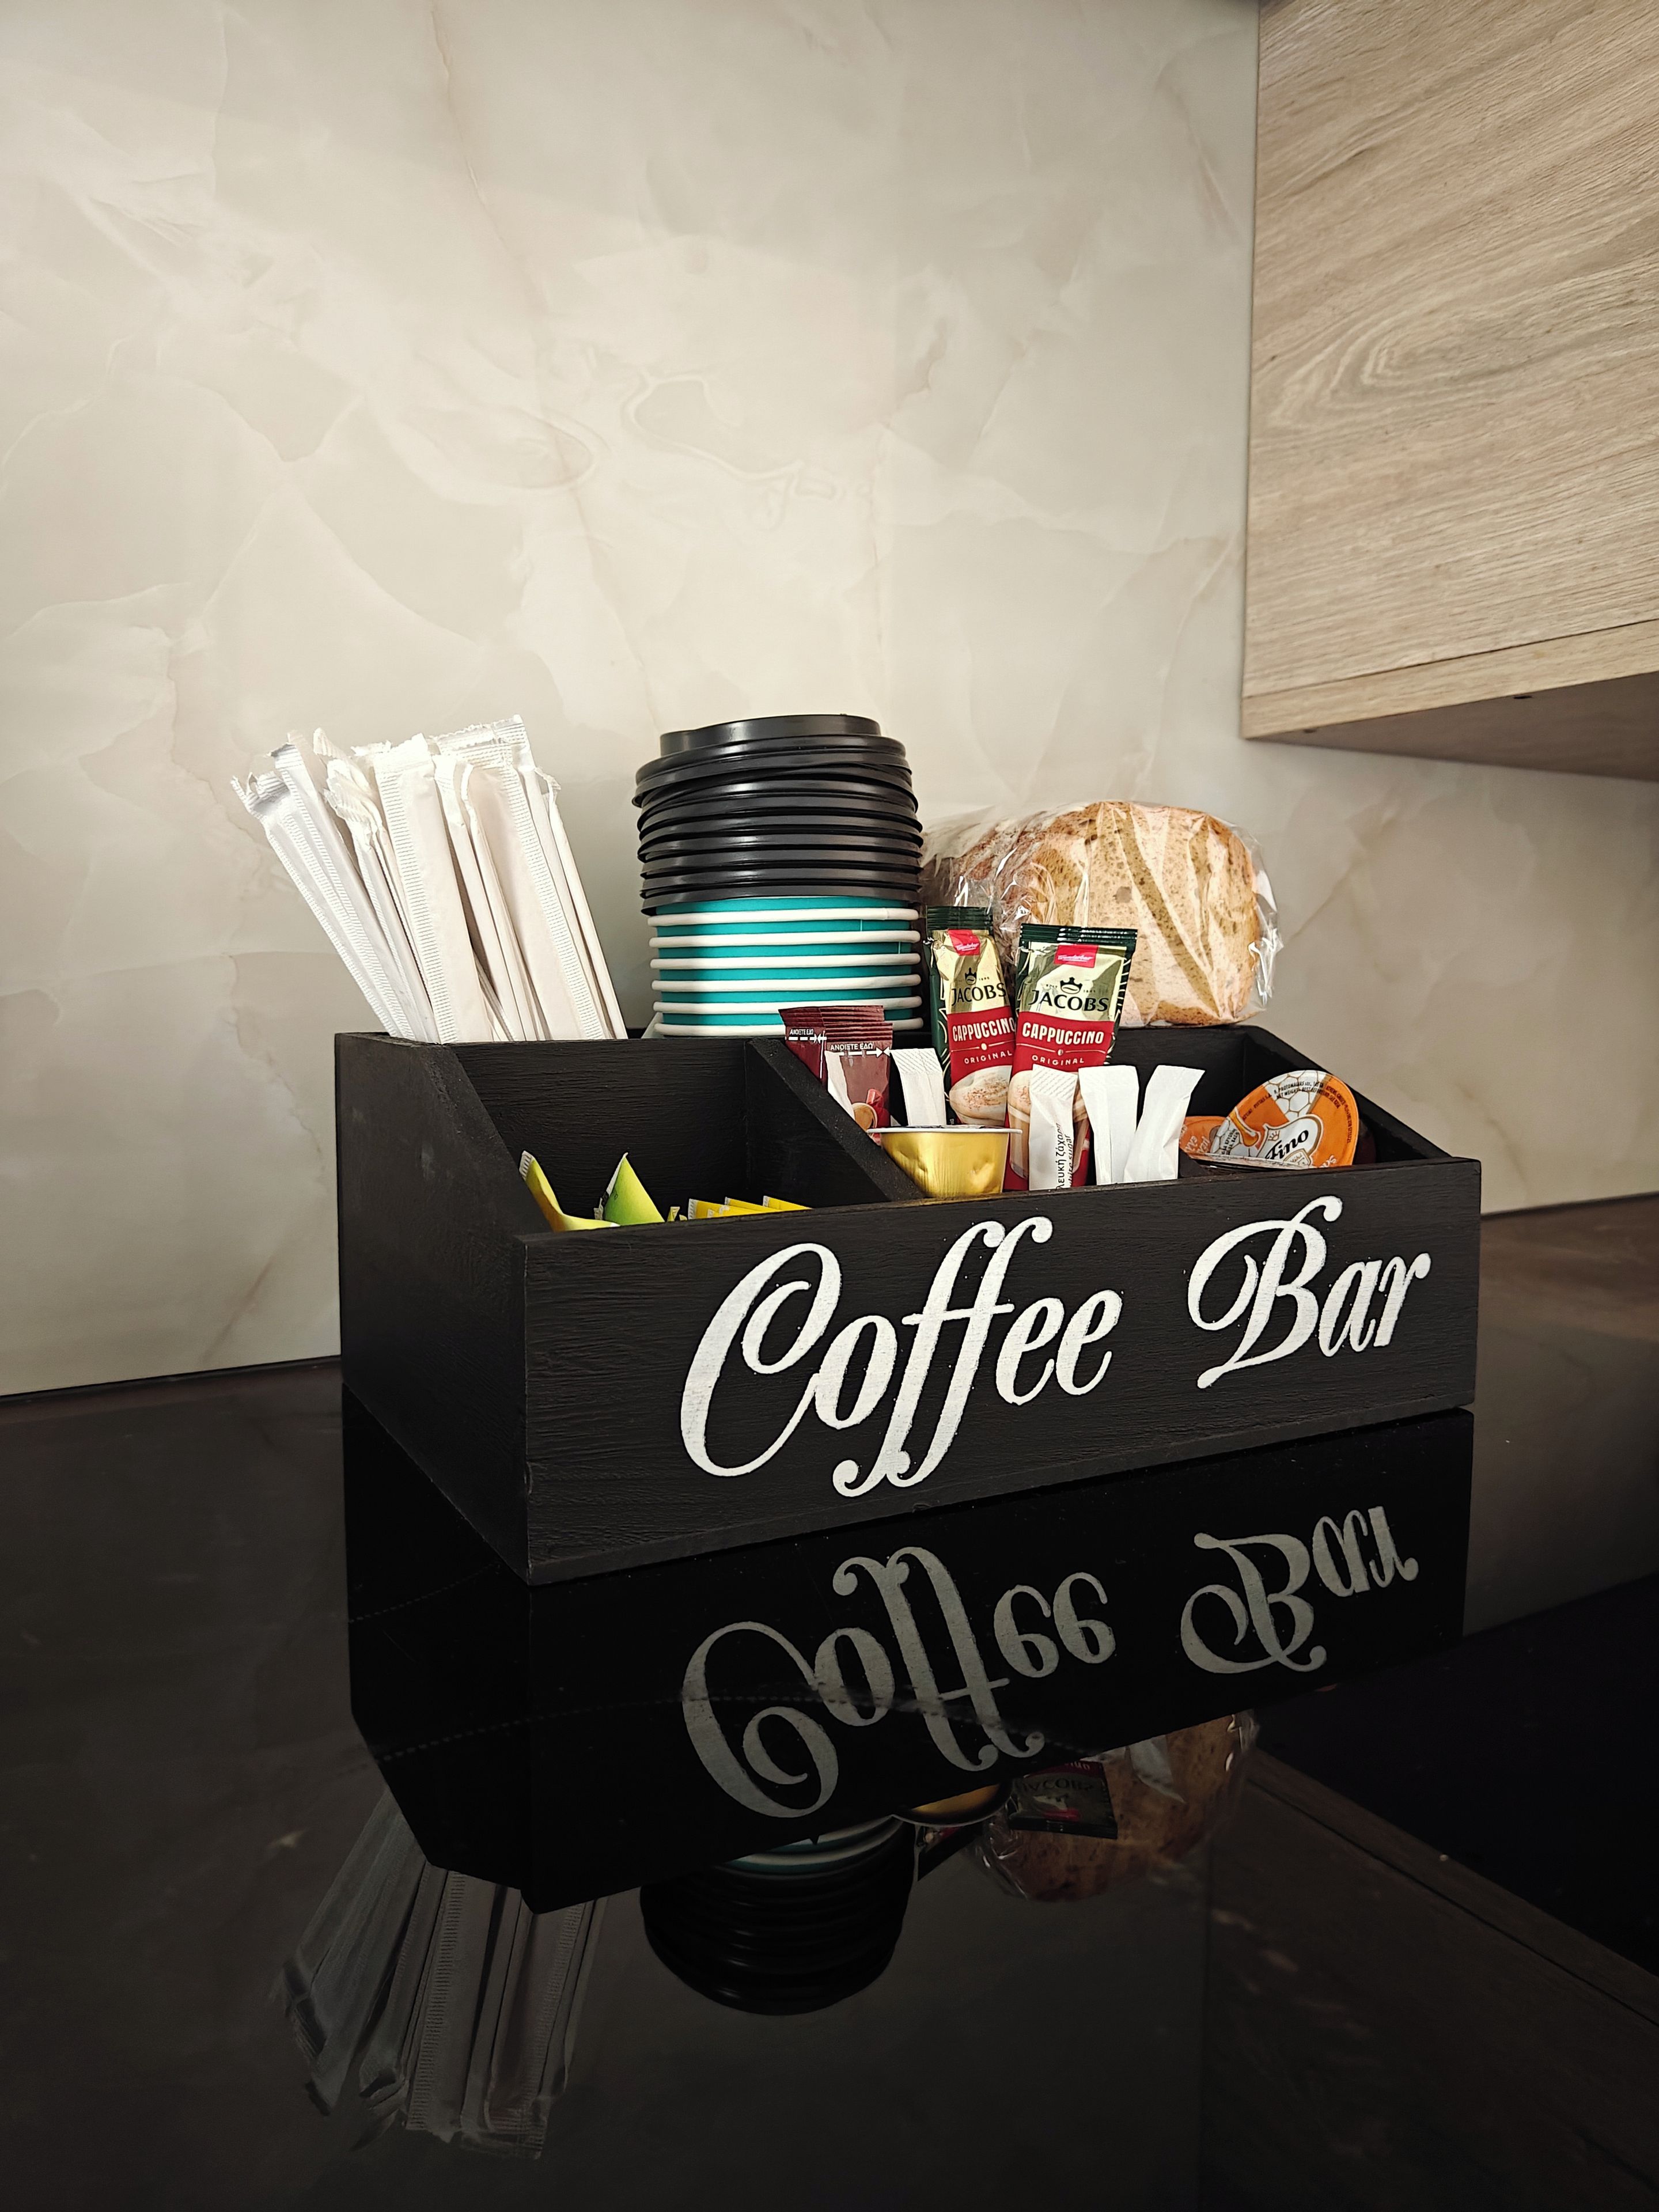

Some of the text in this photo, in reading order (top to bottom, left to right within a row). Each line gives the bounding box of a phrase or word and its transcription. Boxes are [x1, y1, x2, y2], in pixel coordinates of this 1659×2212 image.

[951, 982, 1007, 1006] JACOBS
[1028, 990, 1109, 1012] JACOBS
[952, 1017, 1015, 1042] CAPPUCCINO
[1022, 1022, 1104, 1046] CAPPUCCINO
[964, 1050, 1013, 1065] ORIGINAL
[1032, 1055, 1084, 1066] ORIGINAL
[1264, 1130, 1309, 1160] Fino
[680, 1195, 1431, 1497] Coffee Bar
